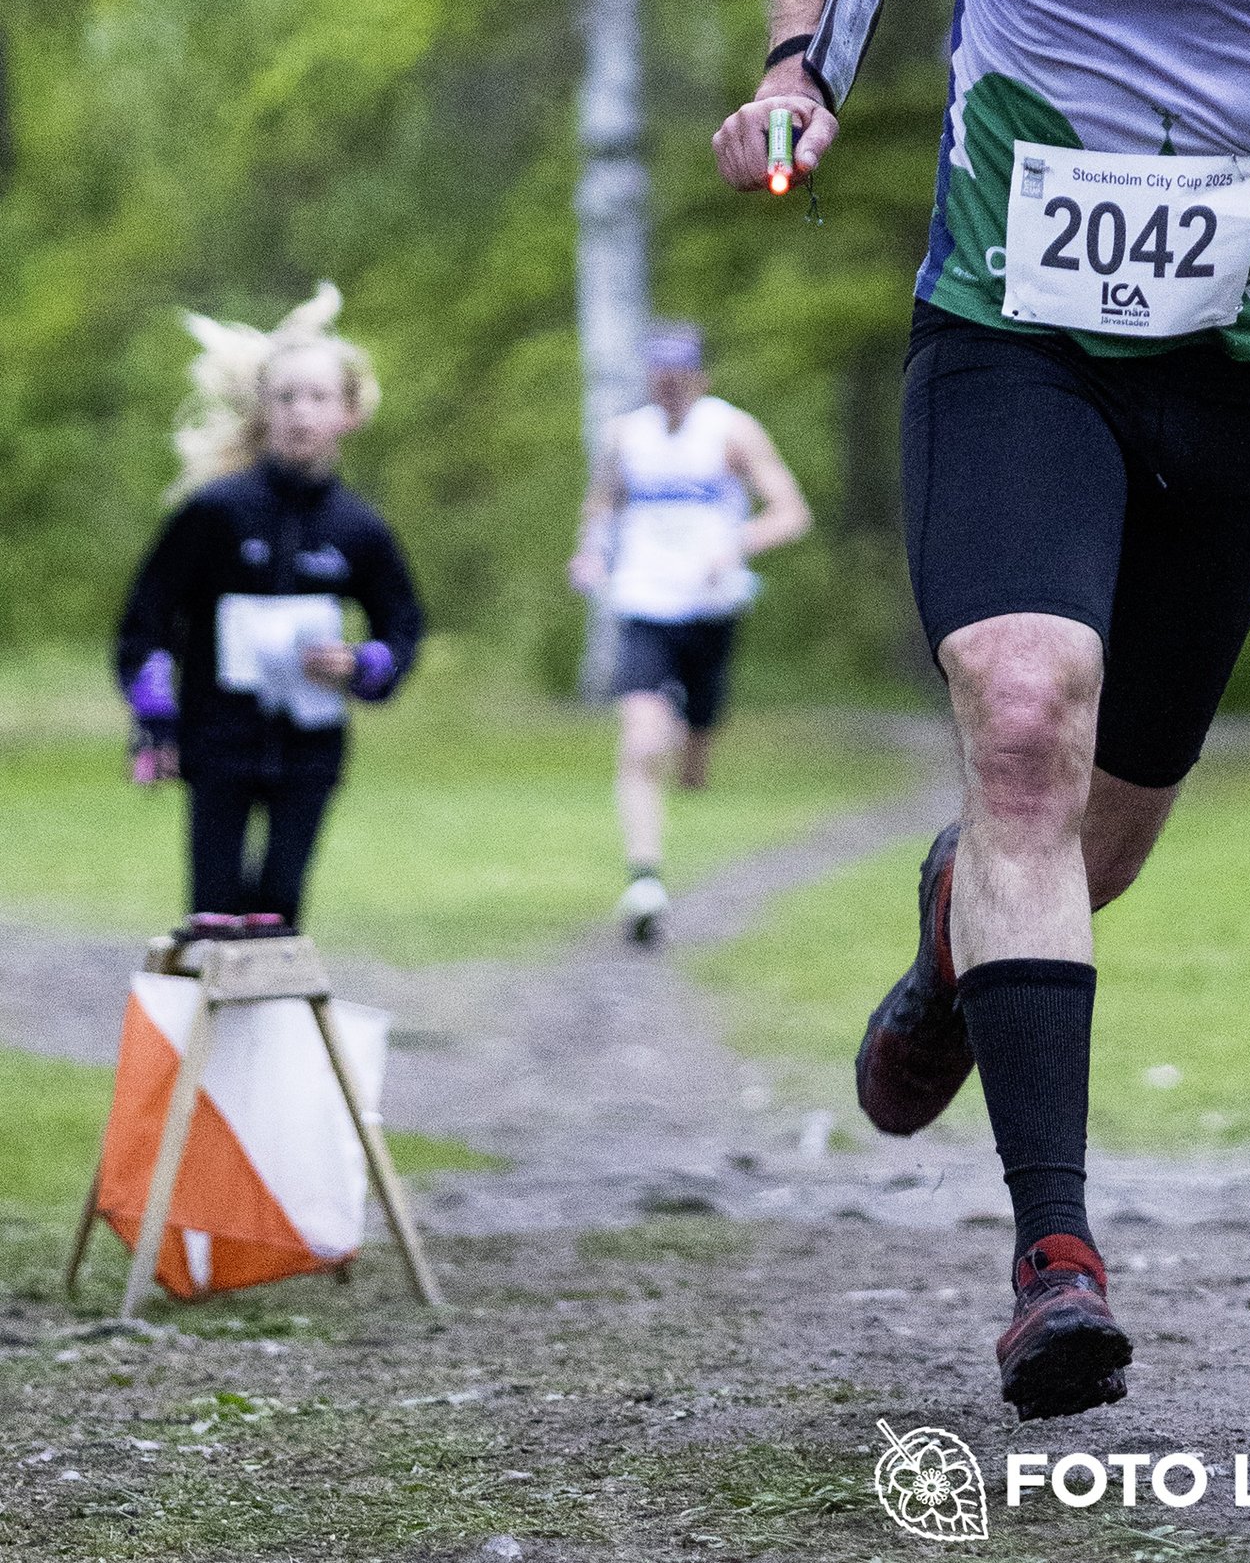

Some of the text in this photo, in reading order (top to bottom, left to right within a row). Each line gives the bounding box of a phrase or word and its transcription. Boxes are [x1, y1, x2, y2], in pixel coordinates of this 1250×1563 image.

[1072, 167, 1233, 191] Stockholm City Cup 2025
[1040, 196, 1218, 278] 2042
[1101, 281, 1150, 309] ICA
[1124, 308, 1150, 318] nära
